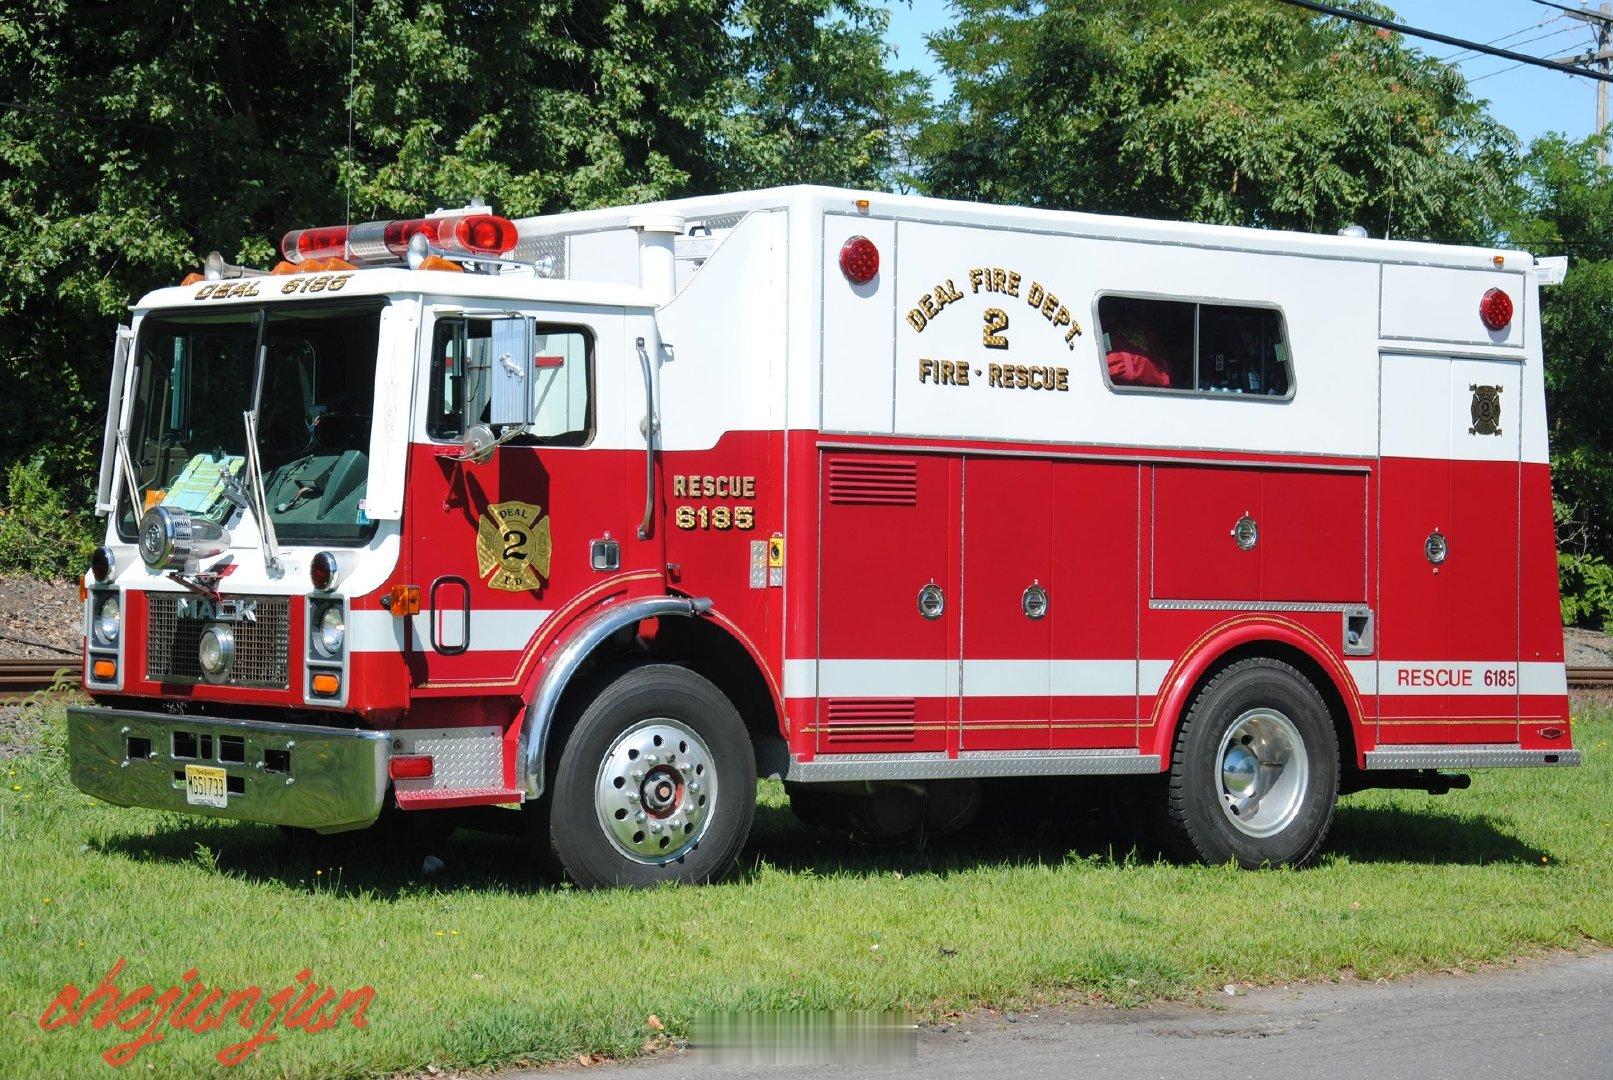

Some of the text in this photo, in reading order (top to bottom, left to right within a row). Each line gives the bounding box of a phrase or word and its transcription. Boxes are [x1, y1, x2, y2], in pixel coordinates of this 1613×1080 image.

[194, 273, 355, 300] DEAL 6185
[905, 267, 1082, 351] DEAL FIRE DEPT.
[983, 307, 1009, 350] 2
[918, 358, 1069, 392] FIRE RESCUE
[673, 475, 756, 499] RESCUE
[499, 508, 528, 520] DEAL
[675, 505, 755, 531] 6185
[502, 530, 528, 560] 2
[177, 598, 257, 621] MACK
[1397, 669, 1516, 687] RESCUE 6185
